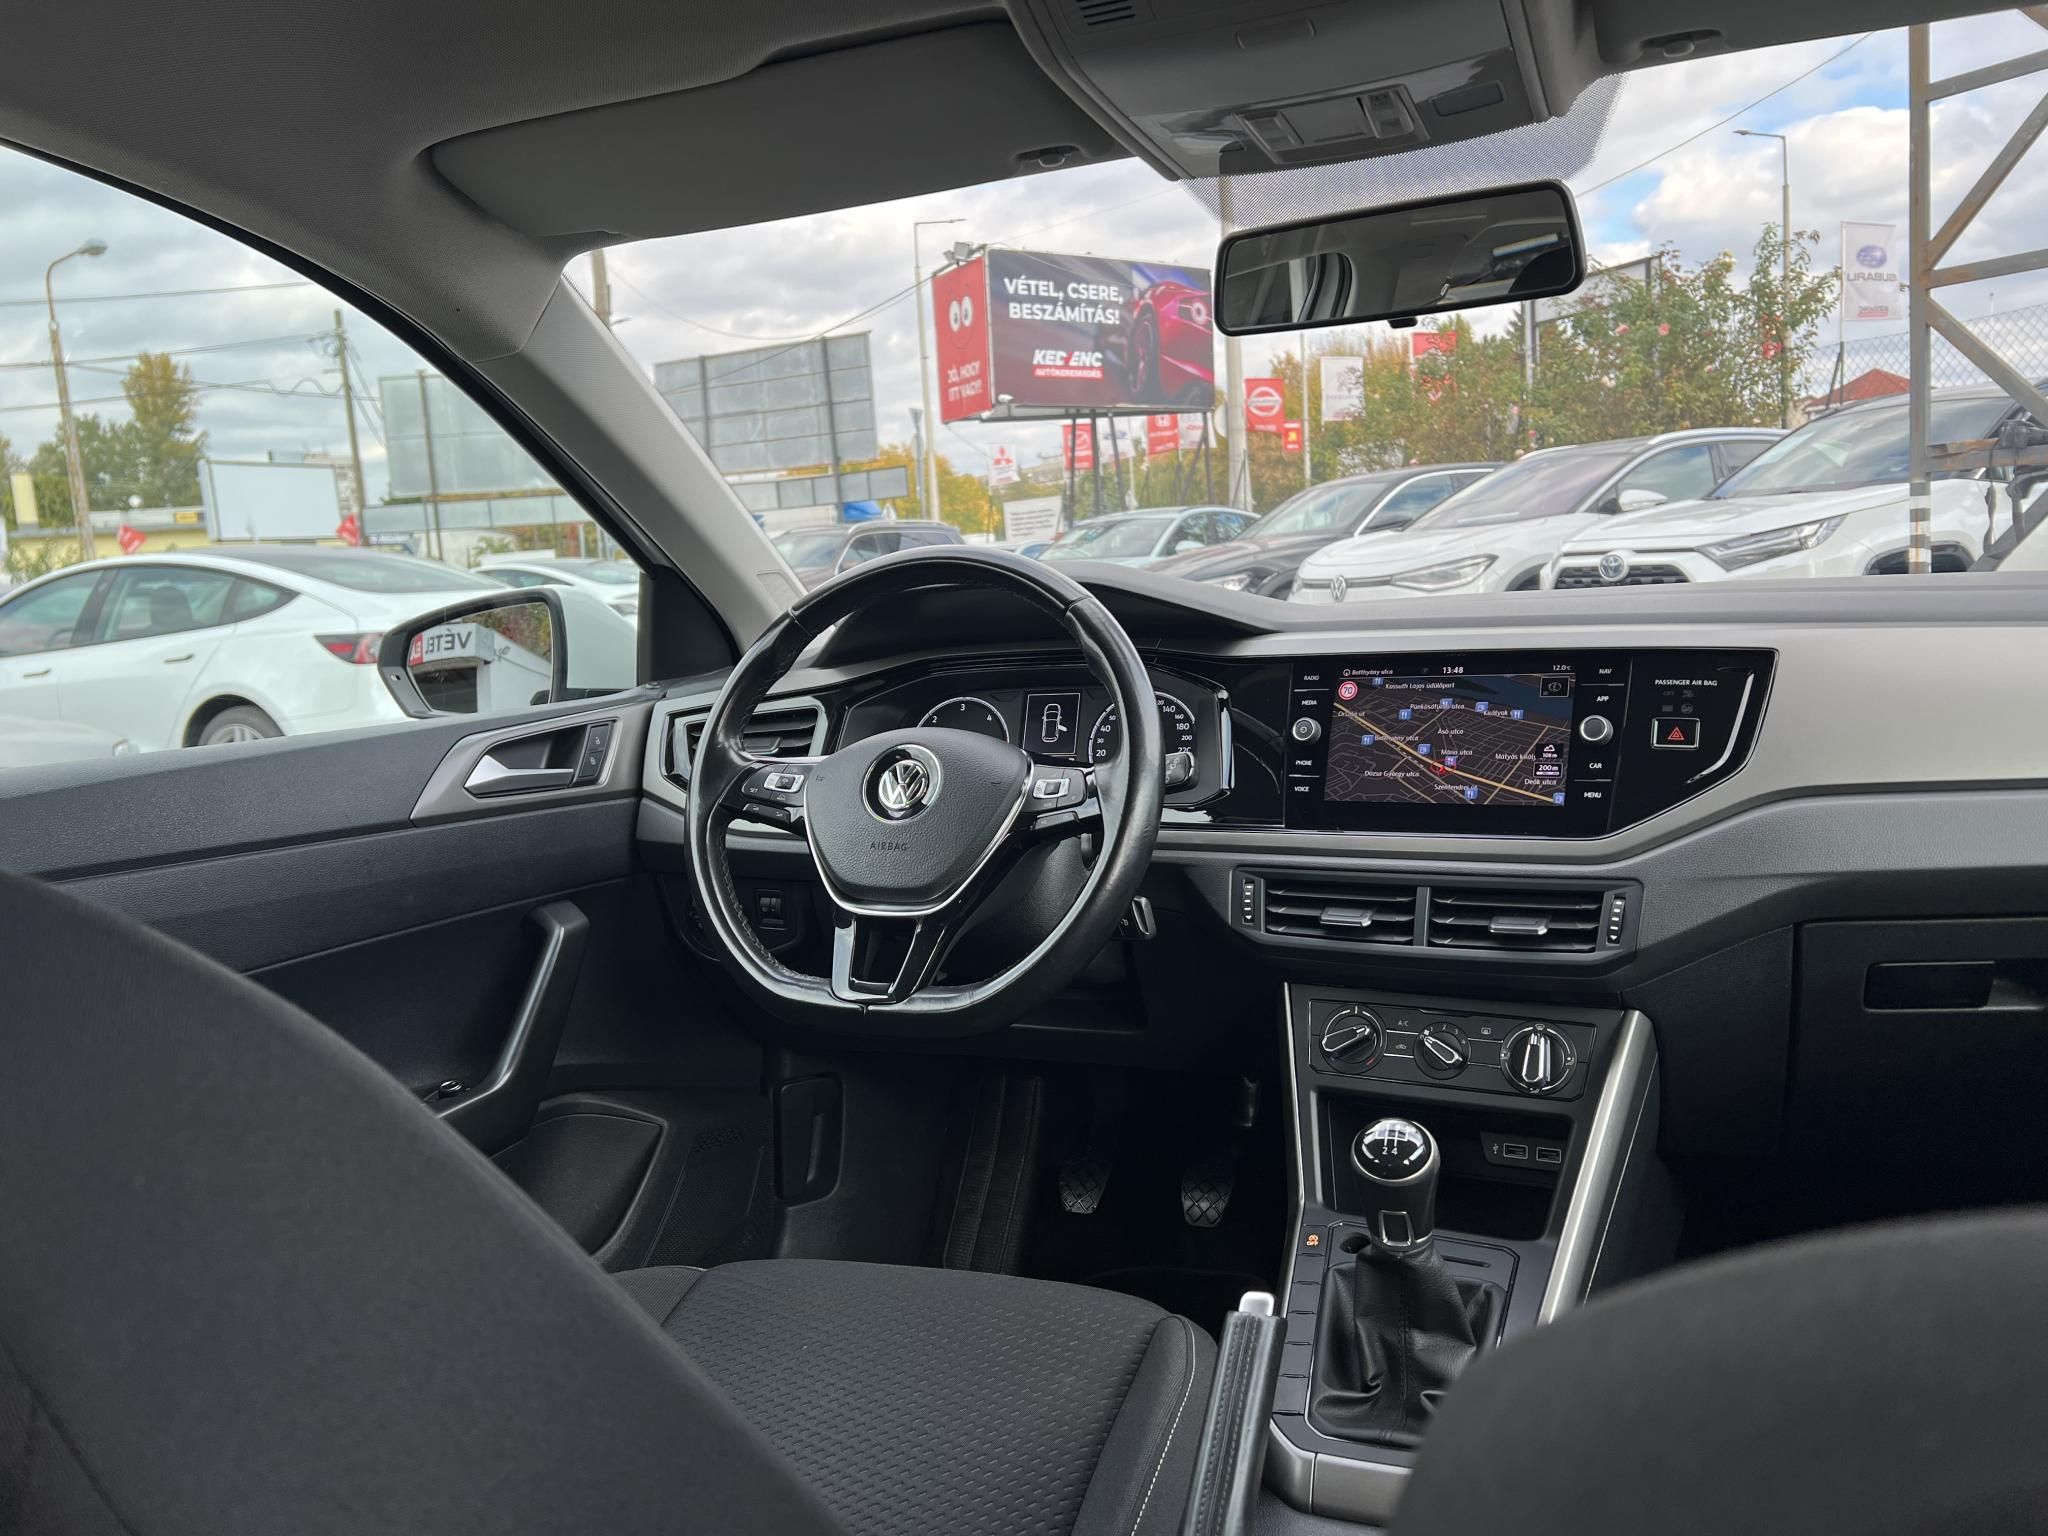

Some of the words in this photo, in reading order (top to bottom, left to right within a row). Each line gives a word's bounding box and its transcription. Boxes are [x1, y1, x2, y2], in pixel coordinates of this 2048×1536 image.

[1003, 275, 1064, 300] VÉTEL,
[1067, 282, 1124, 304] CSERE,
[1008, 302, 1121, 324] BESZÁMÍTÁS!
[1343, 687, 1353, 695] 70
[1163, 705, 1176, 713] 140
[932, 715, 938, 723] 2
[1100, 724, 1111, 732] 40
[1176, 722, 1190, 730] 180
[869, 841, 908, 851] AIRBAG
[1382, 1146, 1388, 1155] 2
[1391, 1146, 1398, 1155] 4
